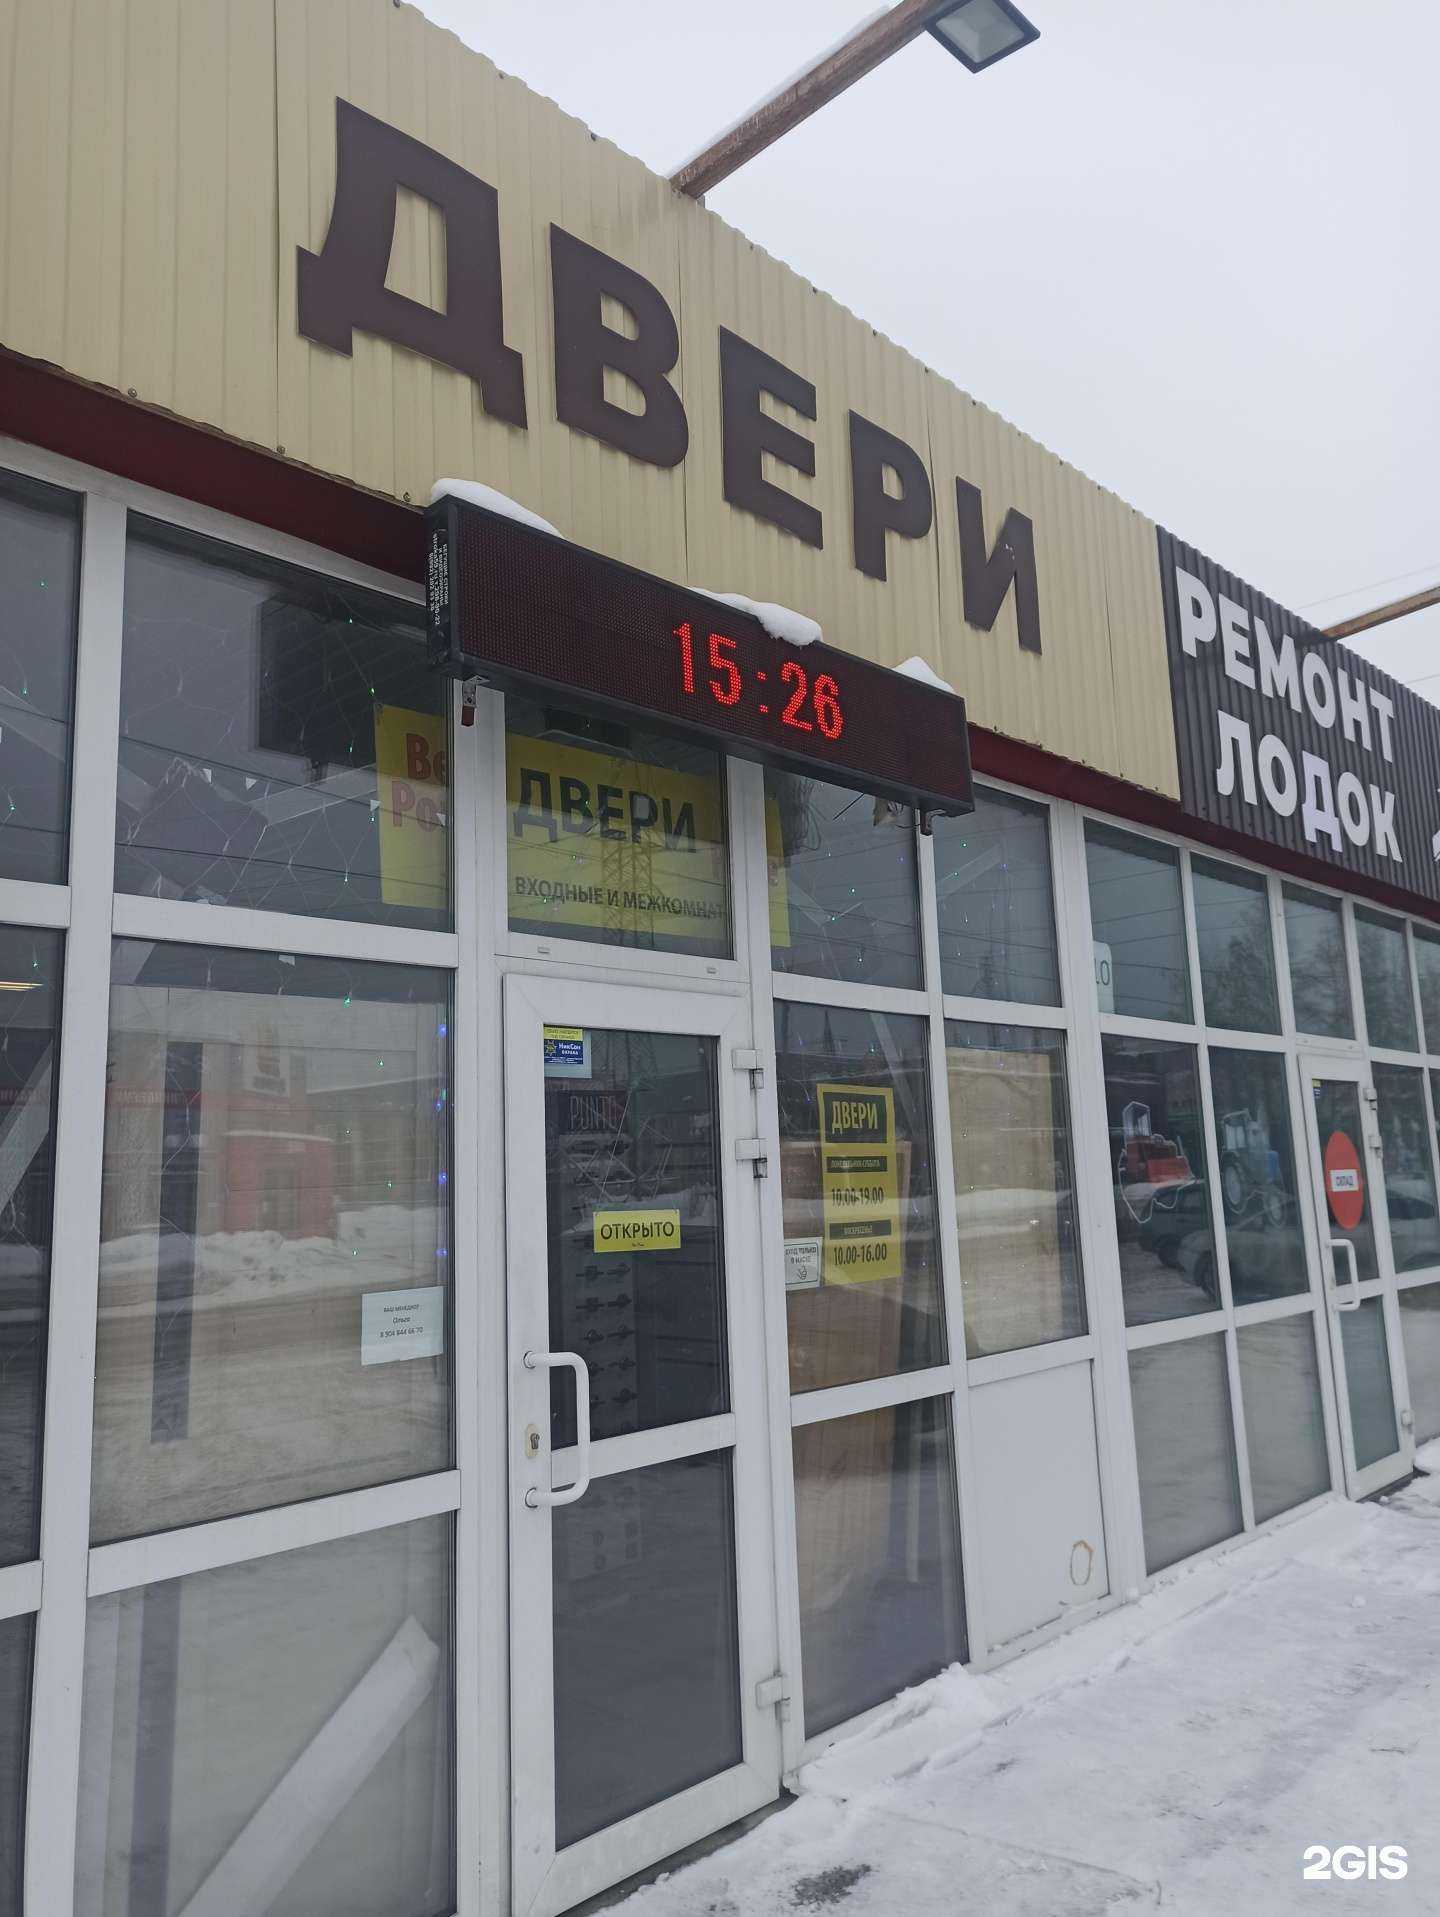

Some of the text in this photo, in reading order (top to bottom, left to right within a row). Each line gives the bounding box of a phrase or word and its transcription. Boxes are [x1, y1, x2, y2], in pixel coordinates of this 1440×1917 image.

[296, 96, 1043, 656] ДВЕРИ
[673, 622, 844, 740] 15:26
[1175, 565, 1394, 764] РЕМОНТ
[511, 767, 697, 853] ДВЕРИ
[1216, 710, 1403, 862] ЛОДОК
[515, 876, 603, 905] ВХОДНЫЕ
[607, 889, 619, 907] И
[831, 1101, 878, 1135] ДВЕРИ
[600, 1221, 675, 1240] ОТКРЫТО
[833, 1243, 887, 1266] 10.00-16.00
